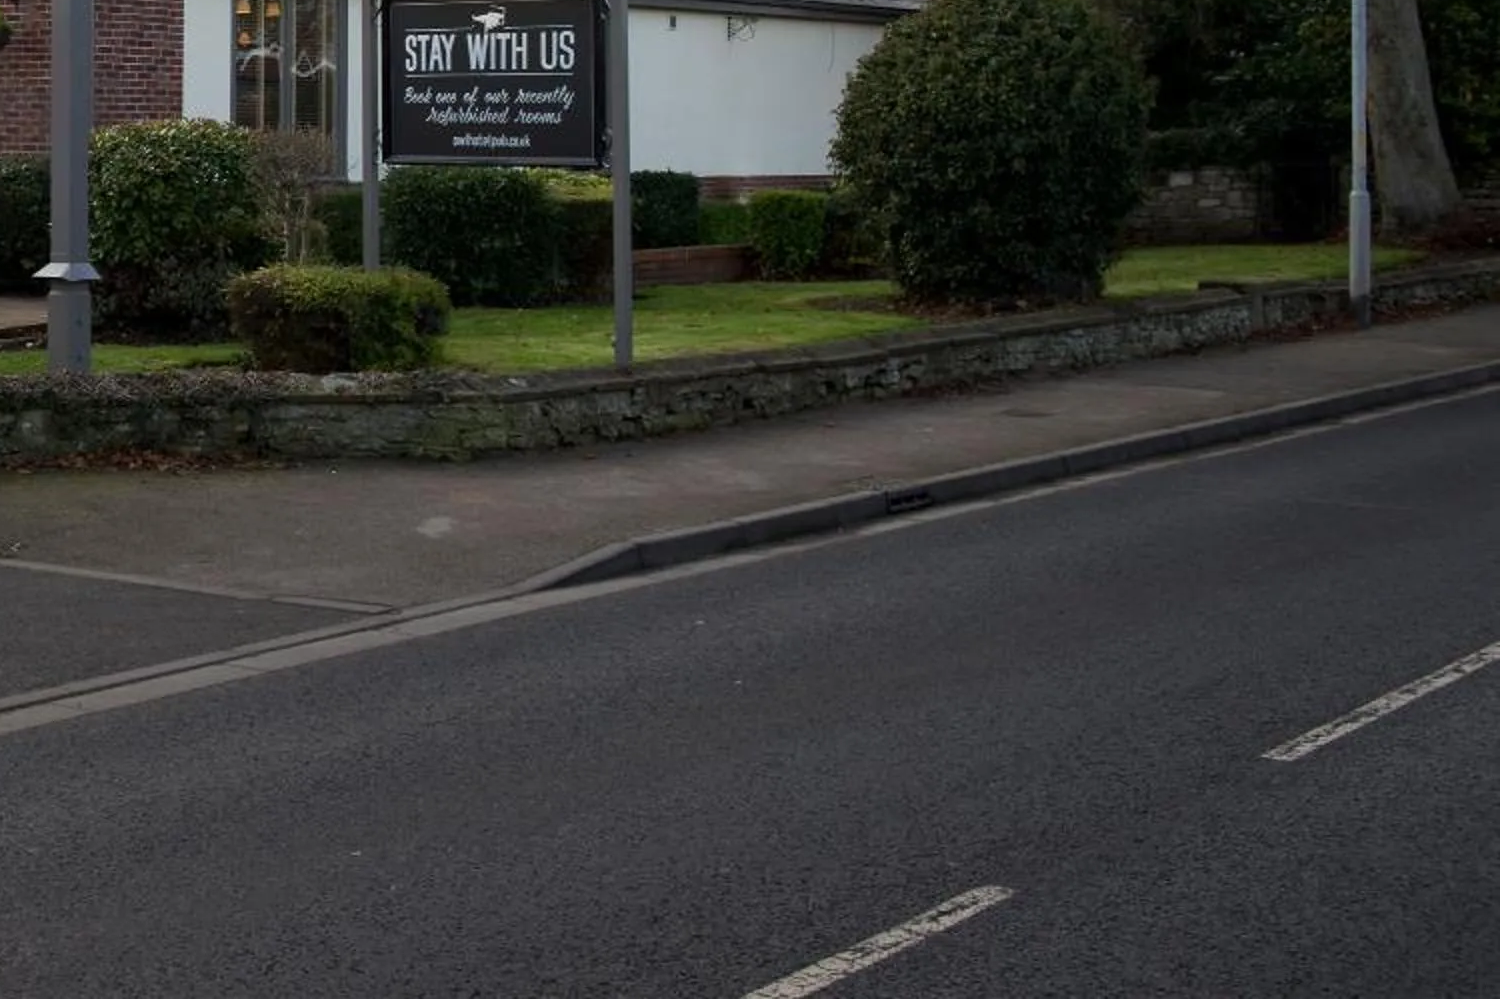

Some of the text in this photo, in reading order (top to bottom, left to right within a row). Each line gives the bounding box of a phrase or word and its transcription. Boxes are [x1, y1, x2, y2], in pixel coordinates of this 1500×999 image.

[405, 30, 575, 72] STAY WITH US
[404, 84, 575, 109] Book one of our recently
[425, 106, 563, 126] refurbished rooms
